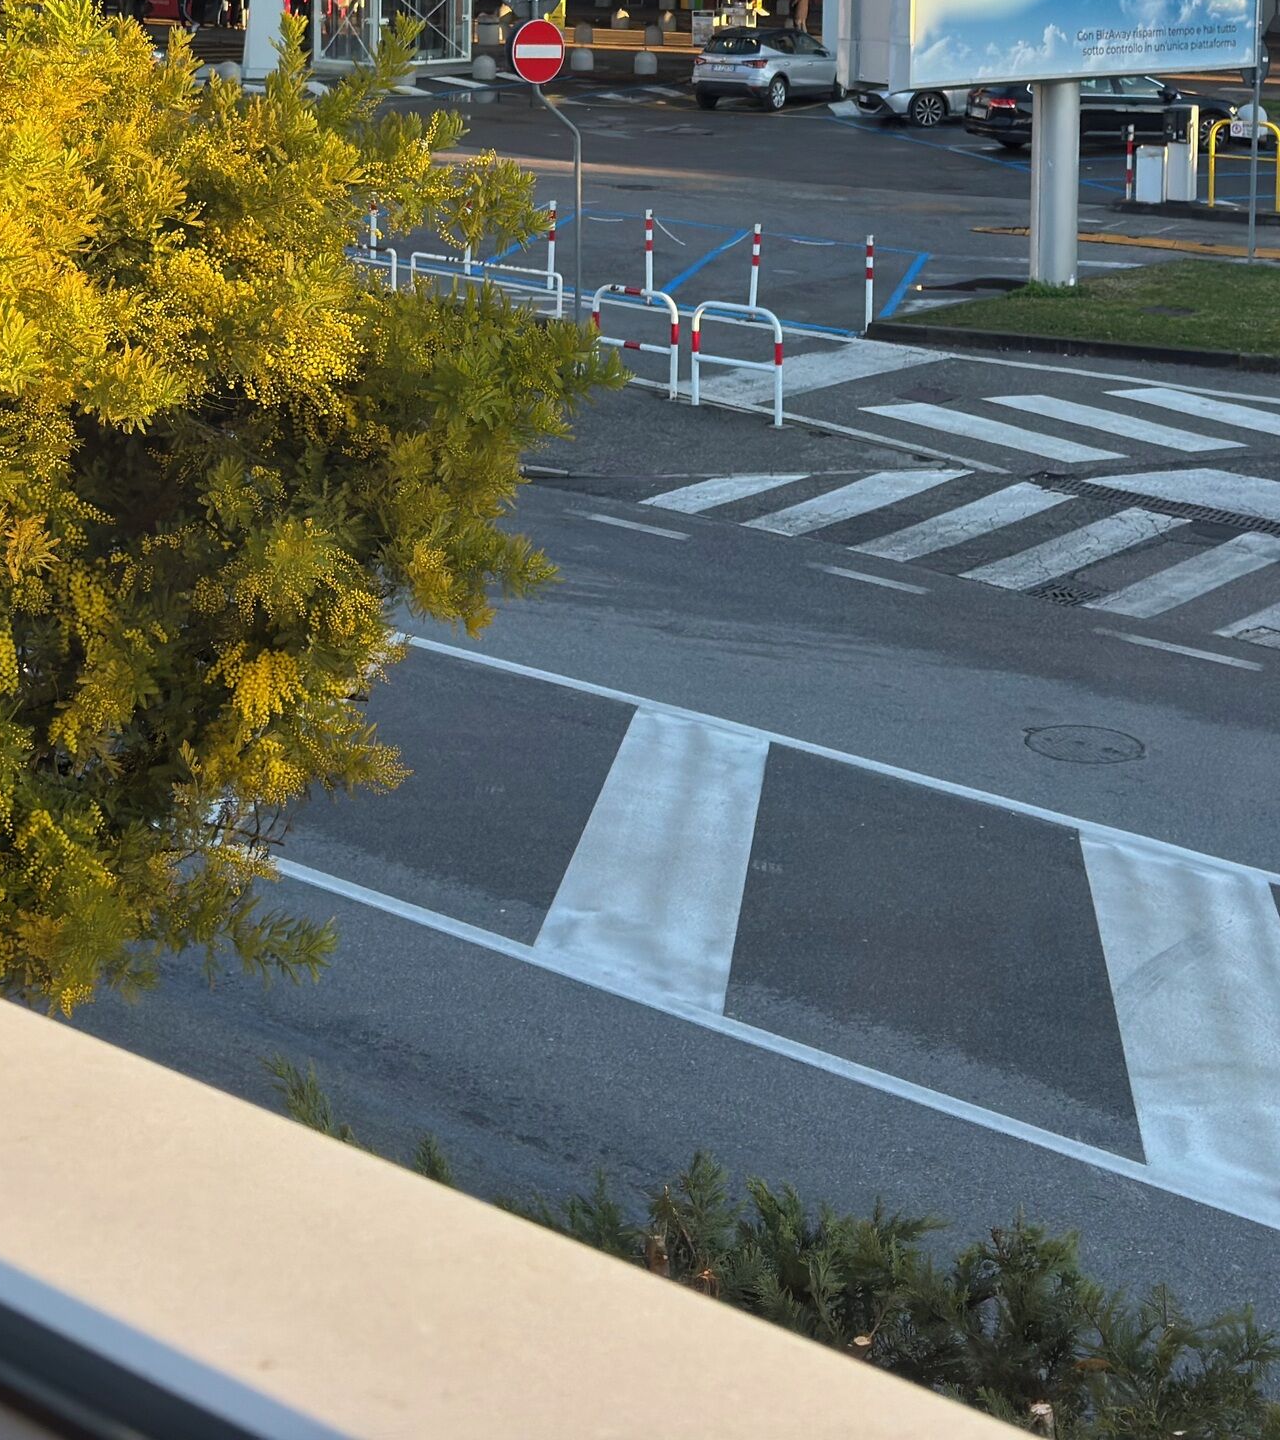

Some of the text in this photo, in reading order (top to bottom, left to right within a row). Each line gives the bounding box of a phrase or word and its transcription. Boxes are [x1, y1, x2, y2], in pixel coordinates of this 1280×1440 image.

[1076, 30, 1094, 42] Con
[1133, 27, 1167, 41] risparmi
[1168, 26, 1195, 39] tempo
[1196, 27, 1202, 36] e
[1203, 24, 1216, 35] hai
[1216, 23, 1237, 34] tutto
[1082, 38, 1237, 57] sotto controllo in un'unica piattaforma
